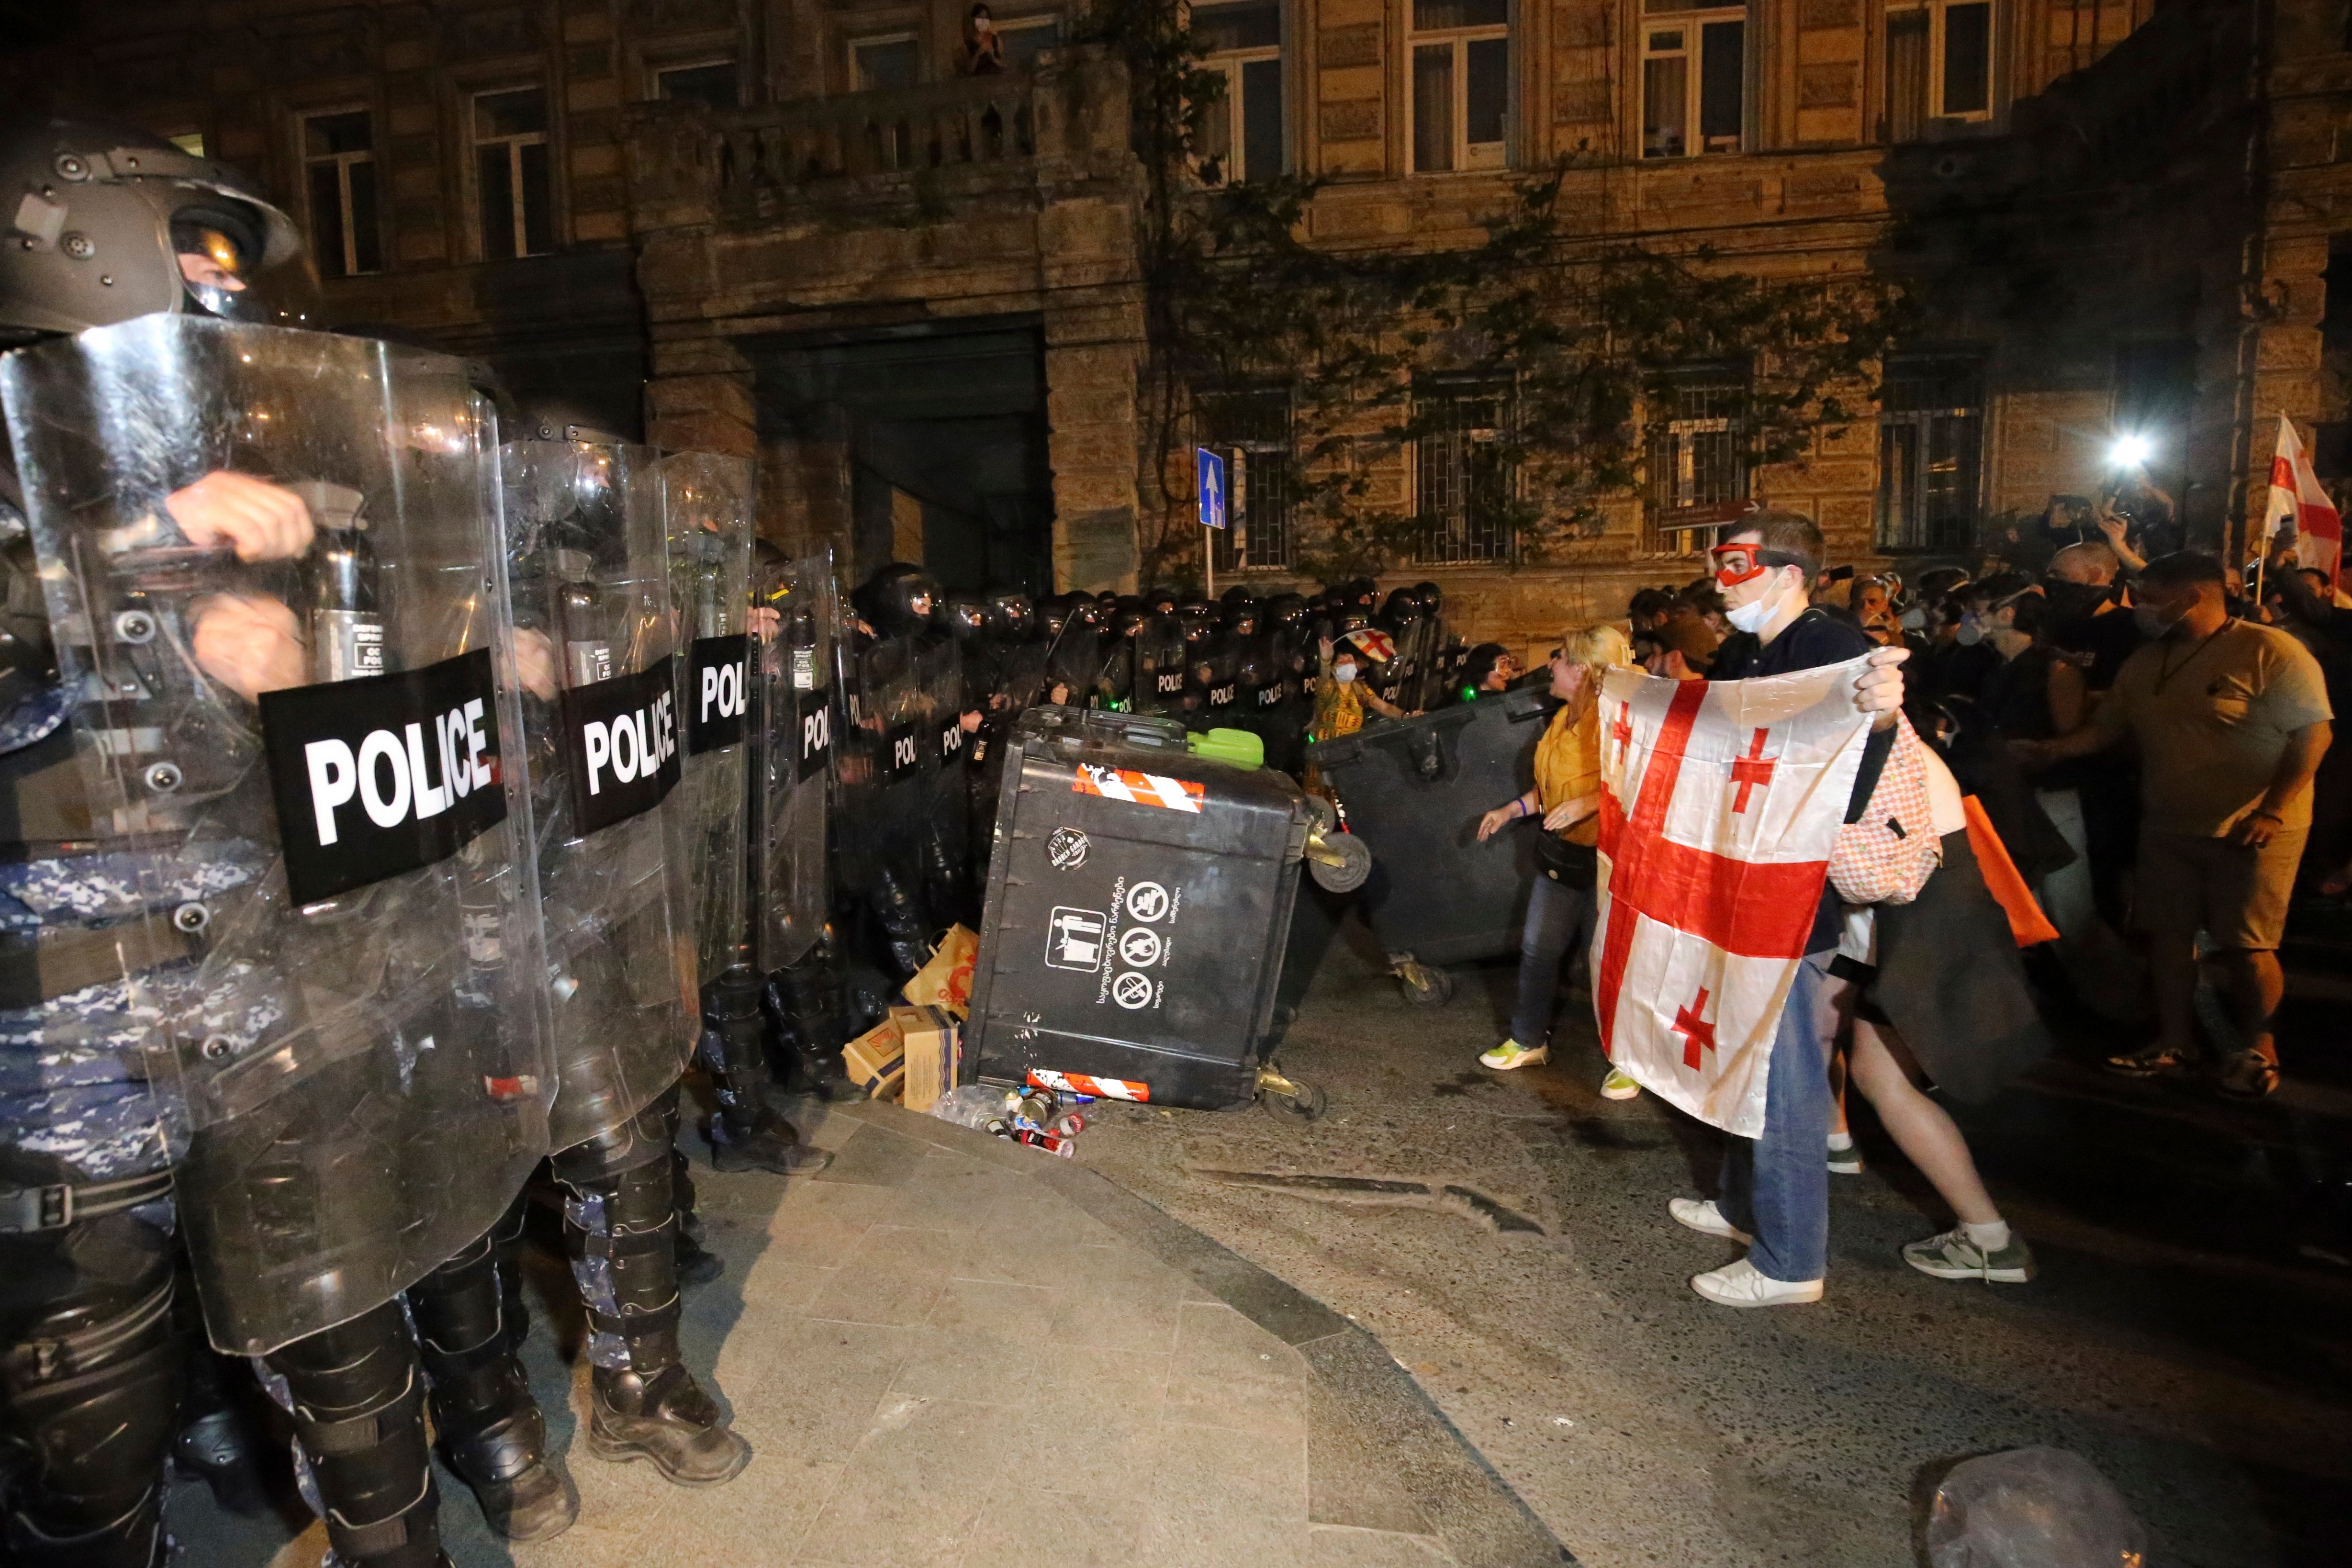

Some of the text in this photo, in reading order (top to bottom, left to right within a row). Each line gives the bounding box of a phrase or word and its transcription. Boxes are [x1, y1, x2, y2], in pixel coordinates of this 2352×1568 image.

[1158, 672, 1183, 693] POLICE
[304, 697, 492, 846] POLICE
[583, 690, 675, 795] POLICE
[1096, 876, 1125, 1004] საყოფაცხოვრებო ნარჩენები
